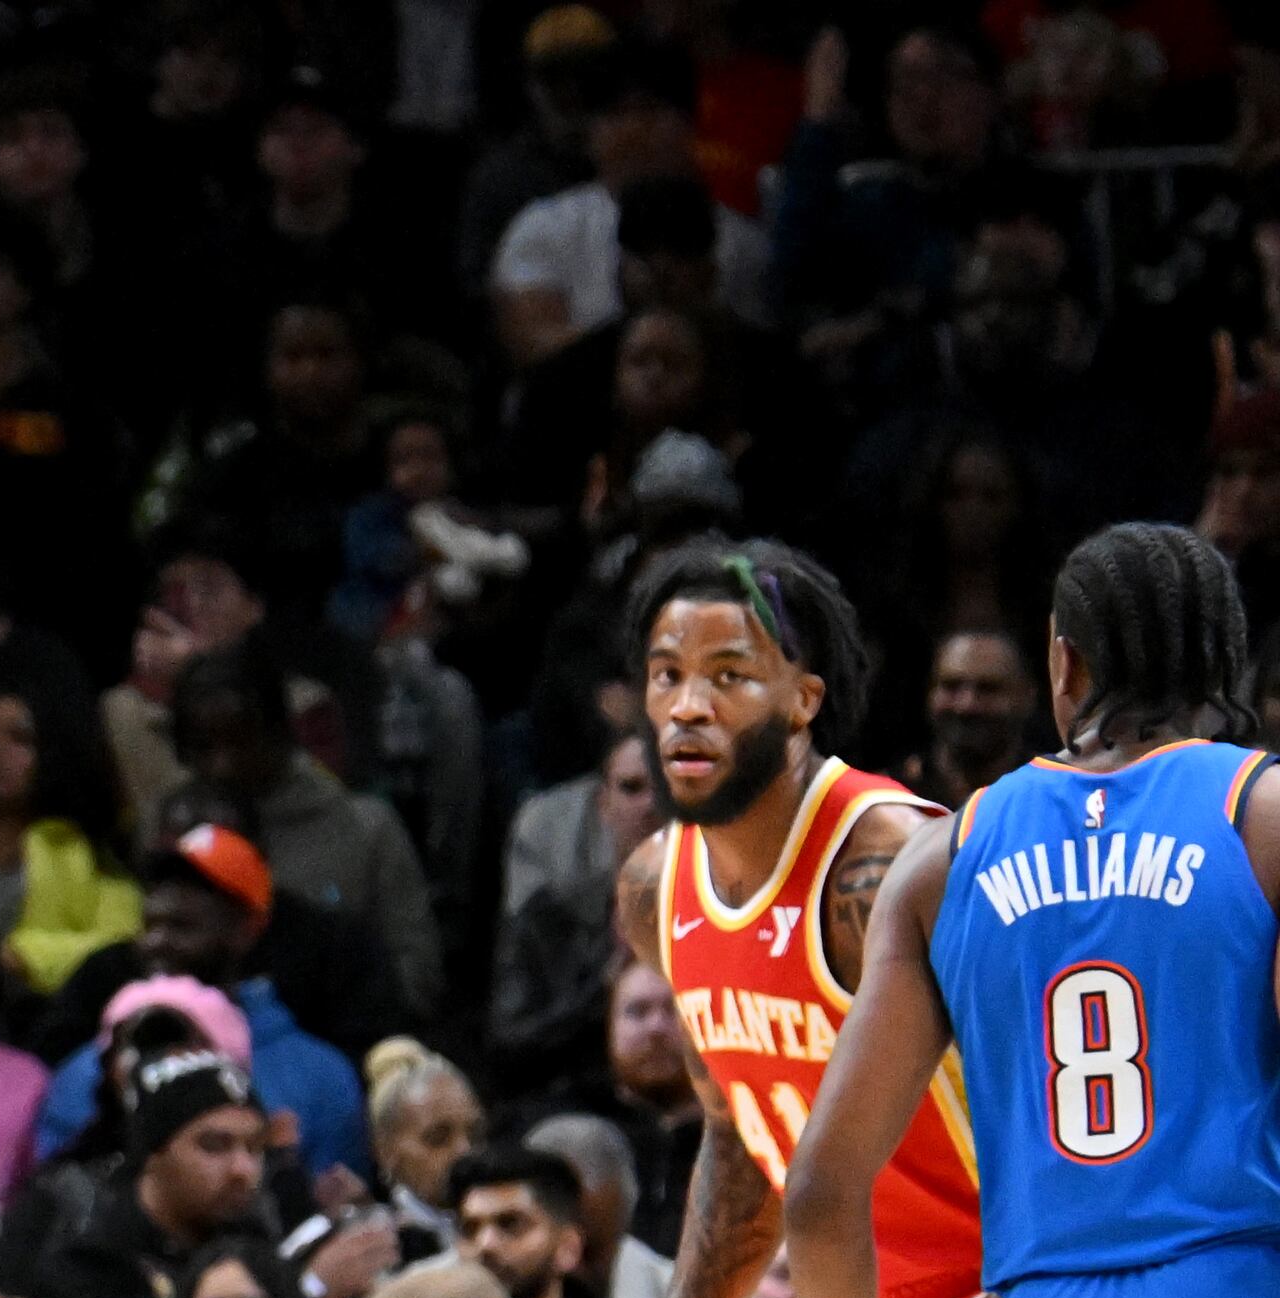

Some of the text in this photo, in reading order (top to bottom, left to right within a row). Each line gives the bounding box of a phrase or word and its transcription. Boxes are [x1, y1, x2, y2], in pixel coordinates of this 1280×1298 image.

[976, 832, 1206, 927] WILLIAMS
[675, 986, 839, 1062] TLANTA
[1044, 960, 1154, 1166] 8
